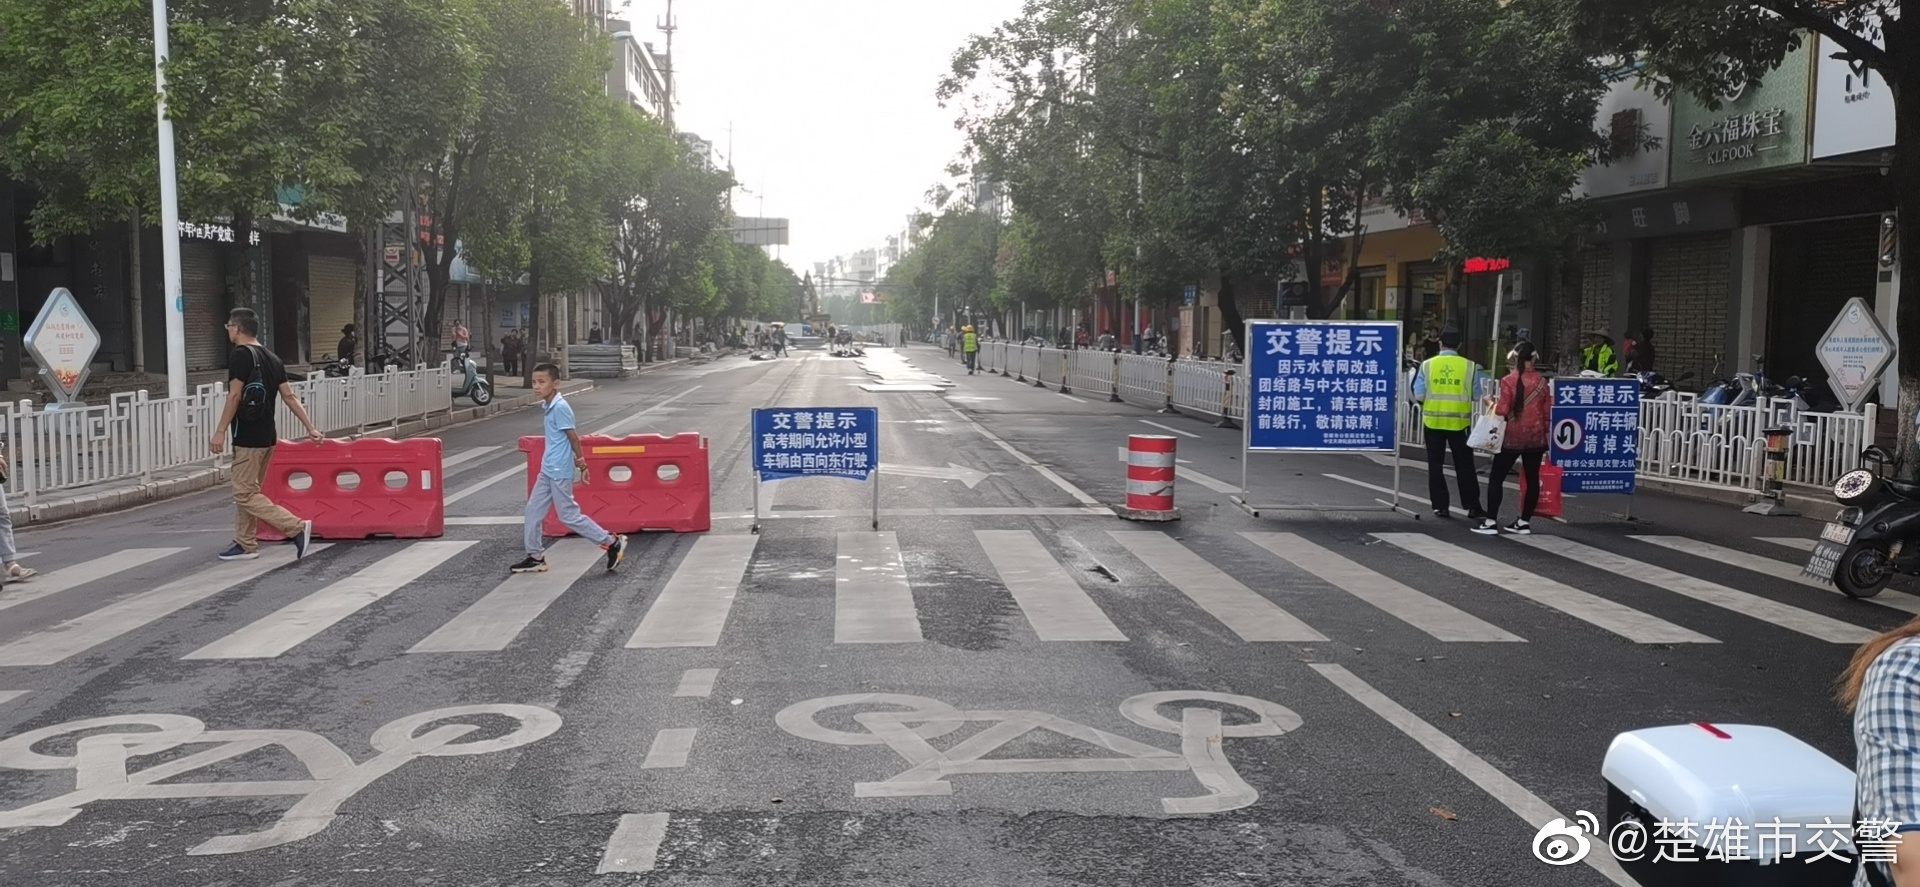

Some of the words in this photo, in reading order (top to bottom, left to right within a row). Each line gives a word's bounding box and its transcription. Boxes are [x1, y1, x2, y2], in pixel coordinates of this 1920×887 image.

[1688, 107, 1782, 150] 金六福珠宝
[1707, 143, 1754, 165] KLFOOK
[1266, 328, 1383, 356] 交警提示
[1278, 359, 1385, 376] 因污水管网改造，
[1258, 377, 1388, 394] 团结路与中大街路口
[1559, 384, 1635, 404] 交警提示
[1258, 396, 1389, 412] 封闭施工，请车辆提
[772, 411, 857, 430] 交警提示
[1258, 414, 1380, 430] 前绕行，敬请谅解！
[1584, 411, 1638, 432] 所有车辆
[762, 432, 868, 450] 高考期间允许小型
[1583, 435, 1636, 455] 请掉头
[762, 452, 868, 469] 车辆由西向东行驶
[1556, 459, 1636, 468] 楚雄市公安局交警大队
